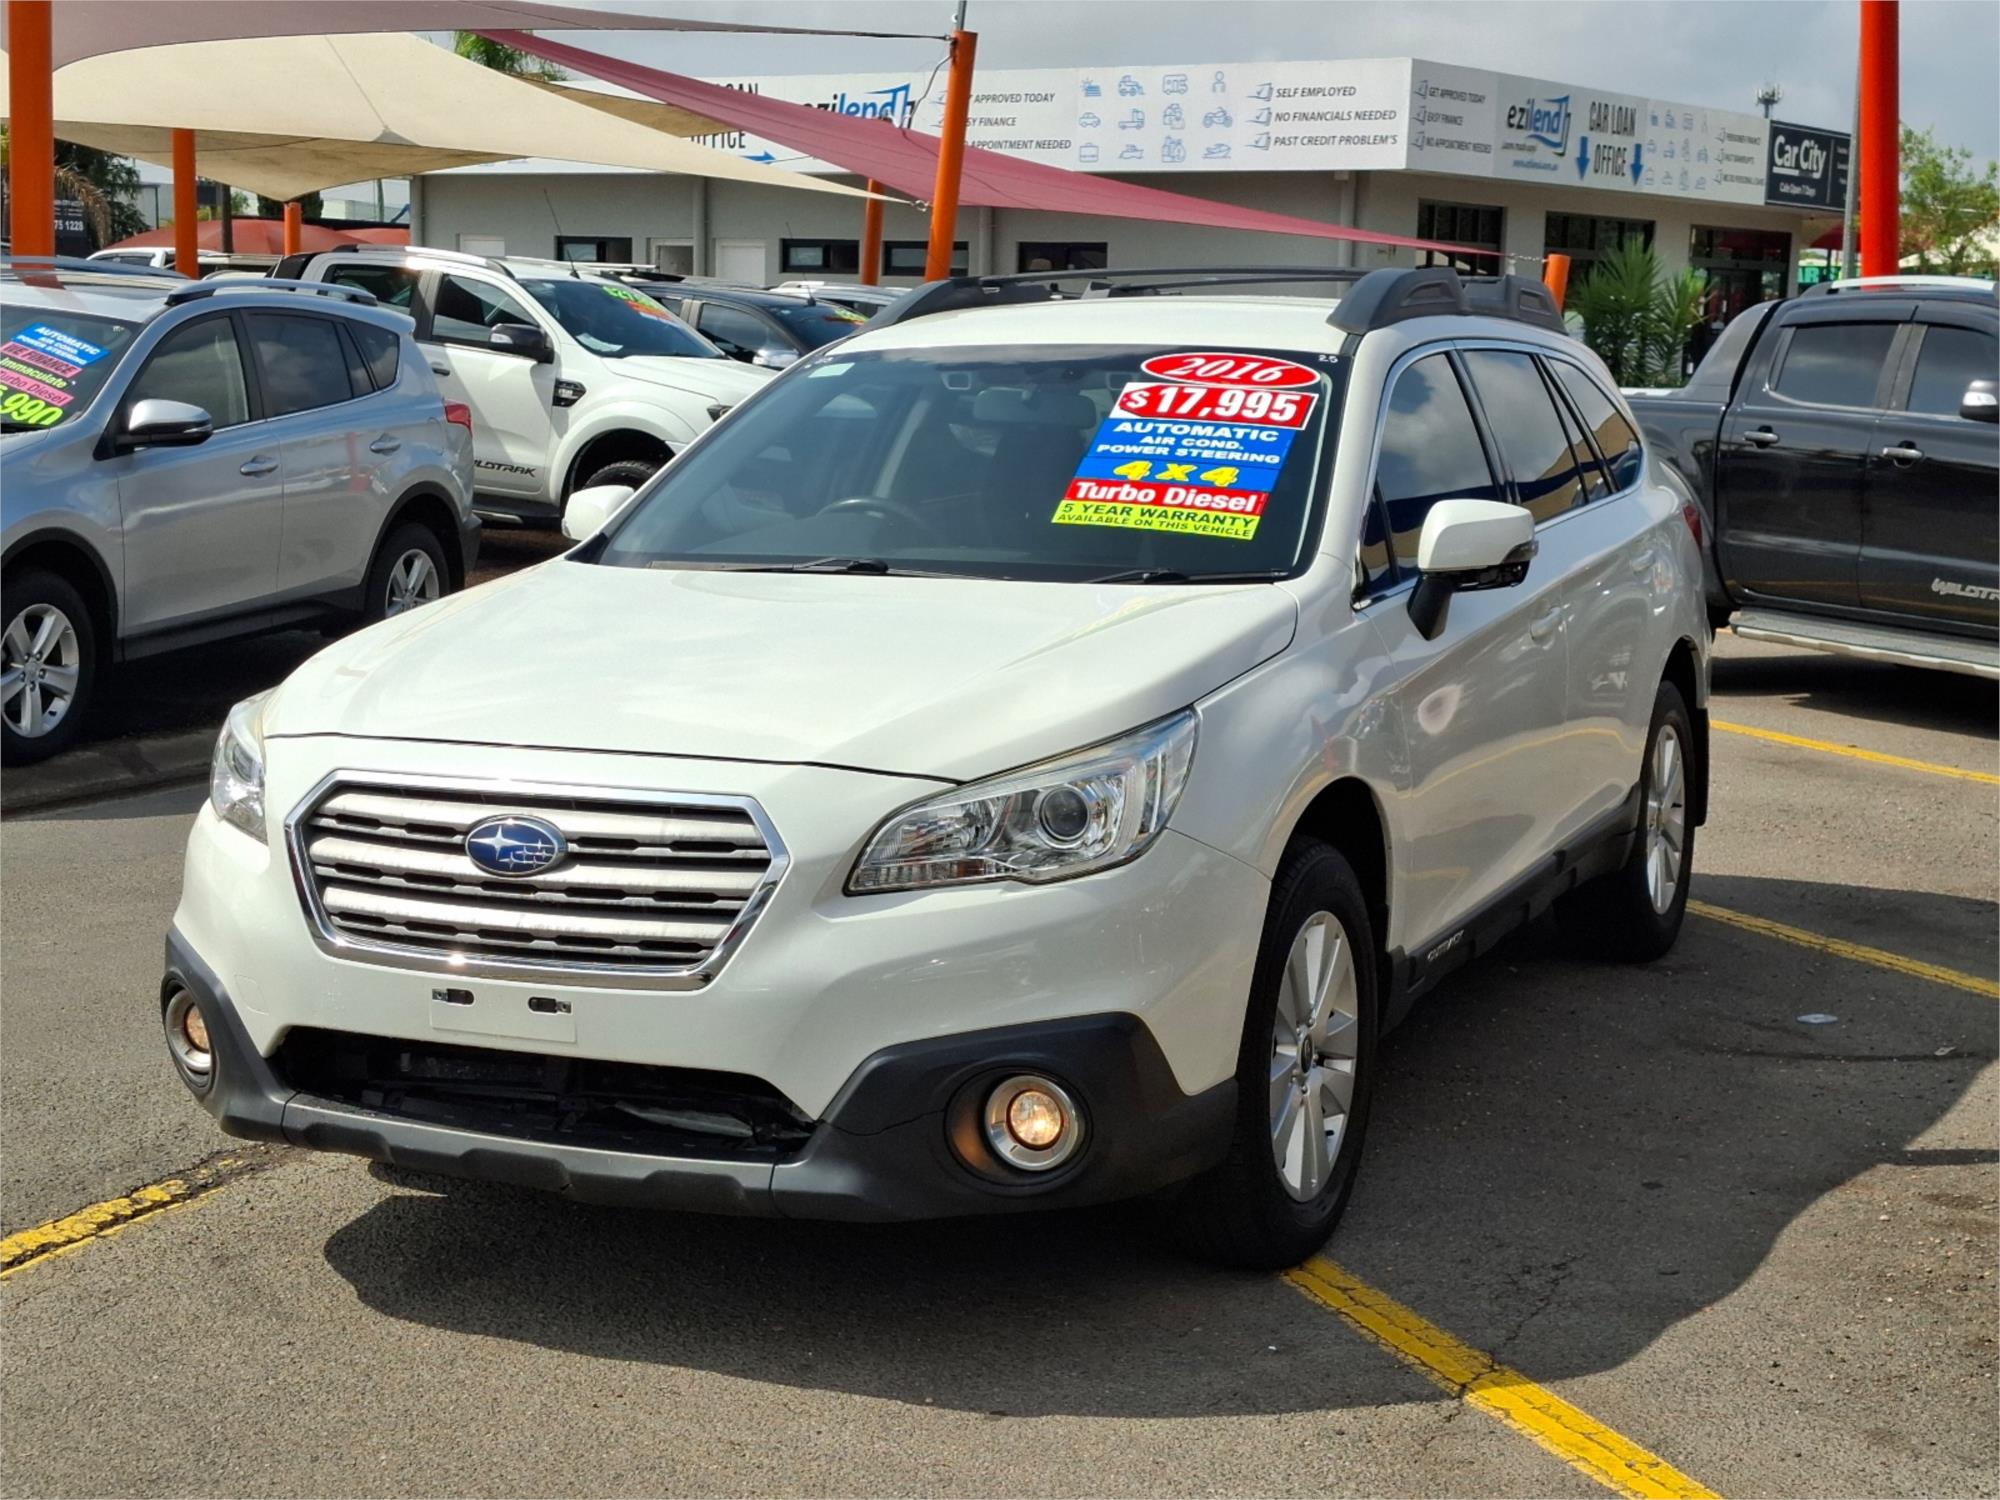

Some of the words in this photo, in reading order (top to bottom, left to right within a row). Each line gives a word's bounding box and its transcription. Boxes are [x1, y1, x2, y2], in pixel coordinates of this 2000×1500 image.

[974, 94, 1022, 103] APPROVED
[1024, 93, 1055, 102] TODAY
[1276, 87, 1299, 98] SELF
[1300, 86, 1357, 97] EMPLOYED
[978, 117, 1017, 126] FINANCE
[1274, 112, 1291, 122] NO
[1292, 110, 1352, 122] FINANCIALS
[1354, 110, 1397, 120] NEEDED
[1589, 101, 1609, 133] CAR
[1611, 104, 1637, 136] LOAN
[971, 140, 1034, 149] APPOINTMENT
[1035, 140, 1071, 149] NEEDED
[1274, 136, 1299, 146] PAST
[1300, 136, 1337, 146] CREDIT
[1339, 134, 1398, 145] PROBLEM'S
[1593, 144, 1627, 177] OFFICE
[1774, 134, 1799, 168] Car
[1800, 139, 1827, 179] City
[34, 327, 101, 355] AUTOMATIC
[0, 356, 67, 388] Immaculate
[20, 350, 79, 375] FINANCE
[1163, 357, 1297, 383] 2016
[27, 383, 69, 404] Diesel
[1113, 422, 1279, 442] AUTOMATIC
[1140, 436, 1176, 446] AIR
[1181, 438, 1244, 450] COND.
[1097, 444, 1170, 456] POWER
[1175, 447, 1281, 464] STEERING
[1076, 481, 1157, 503] Turbo
[1163, 487, 1258, 512] Diesel
[1057, 513, 1129, 525] AVAILABLE
[1134, 518, 1152, 526] ON
[1157, 520, 1188, 530] THIS
[1193, 523, 1251, 537] VEHICLE
[1063, 503, 1074, 513] 5
[1077, 503, 1133, 517] YEAR
[1140, 507, 1256, 529] WARRANTY
